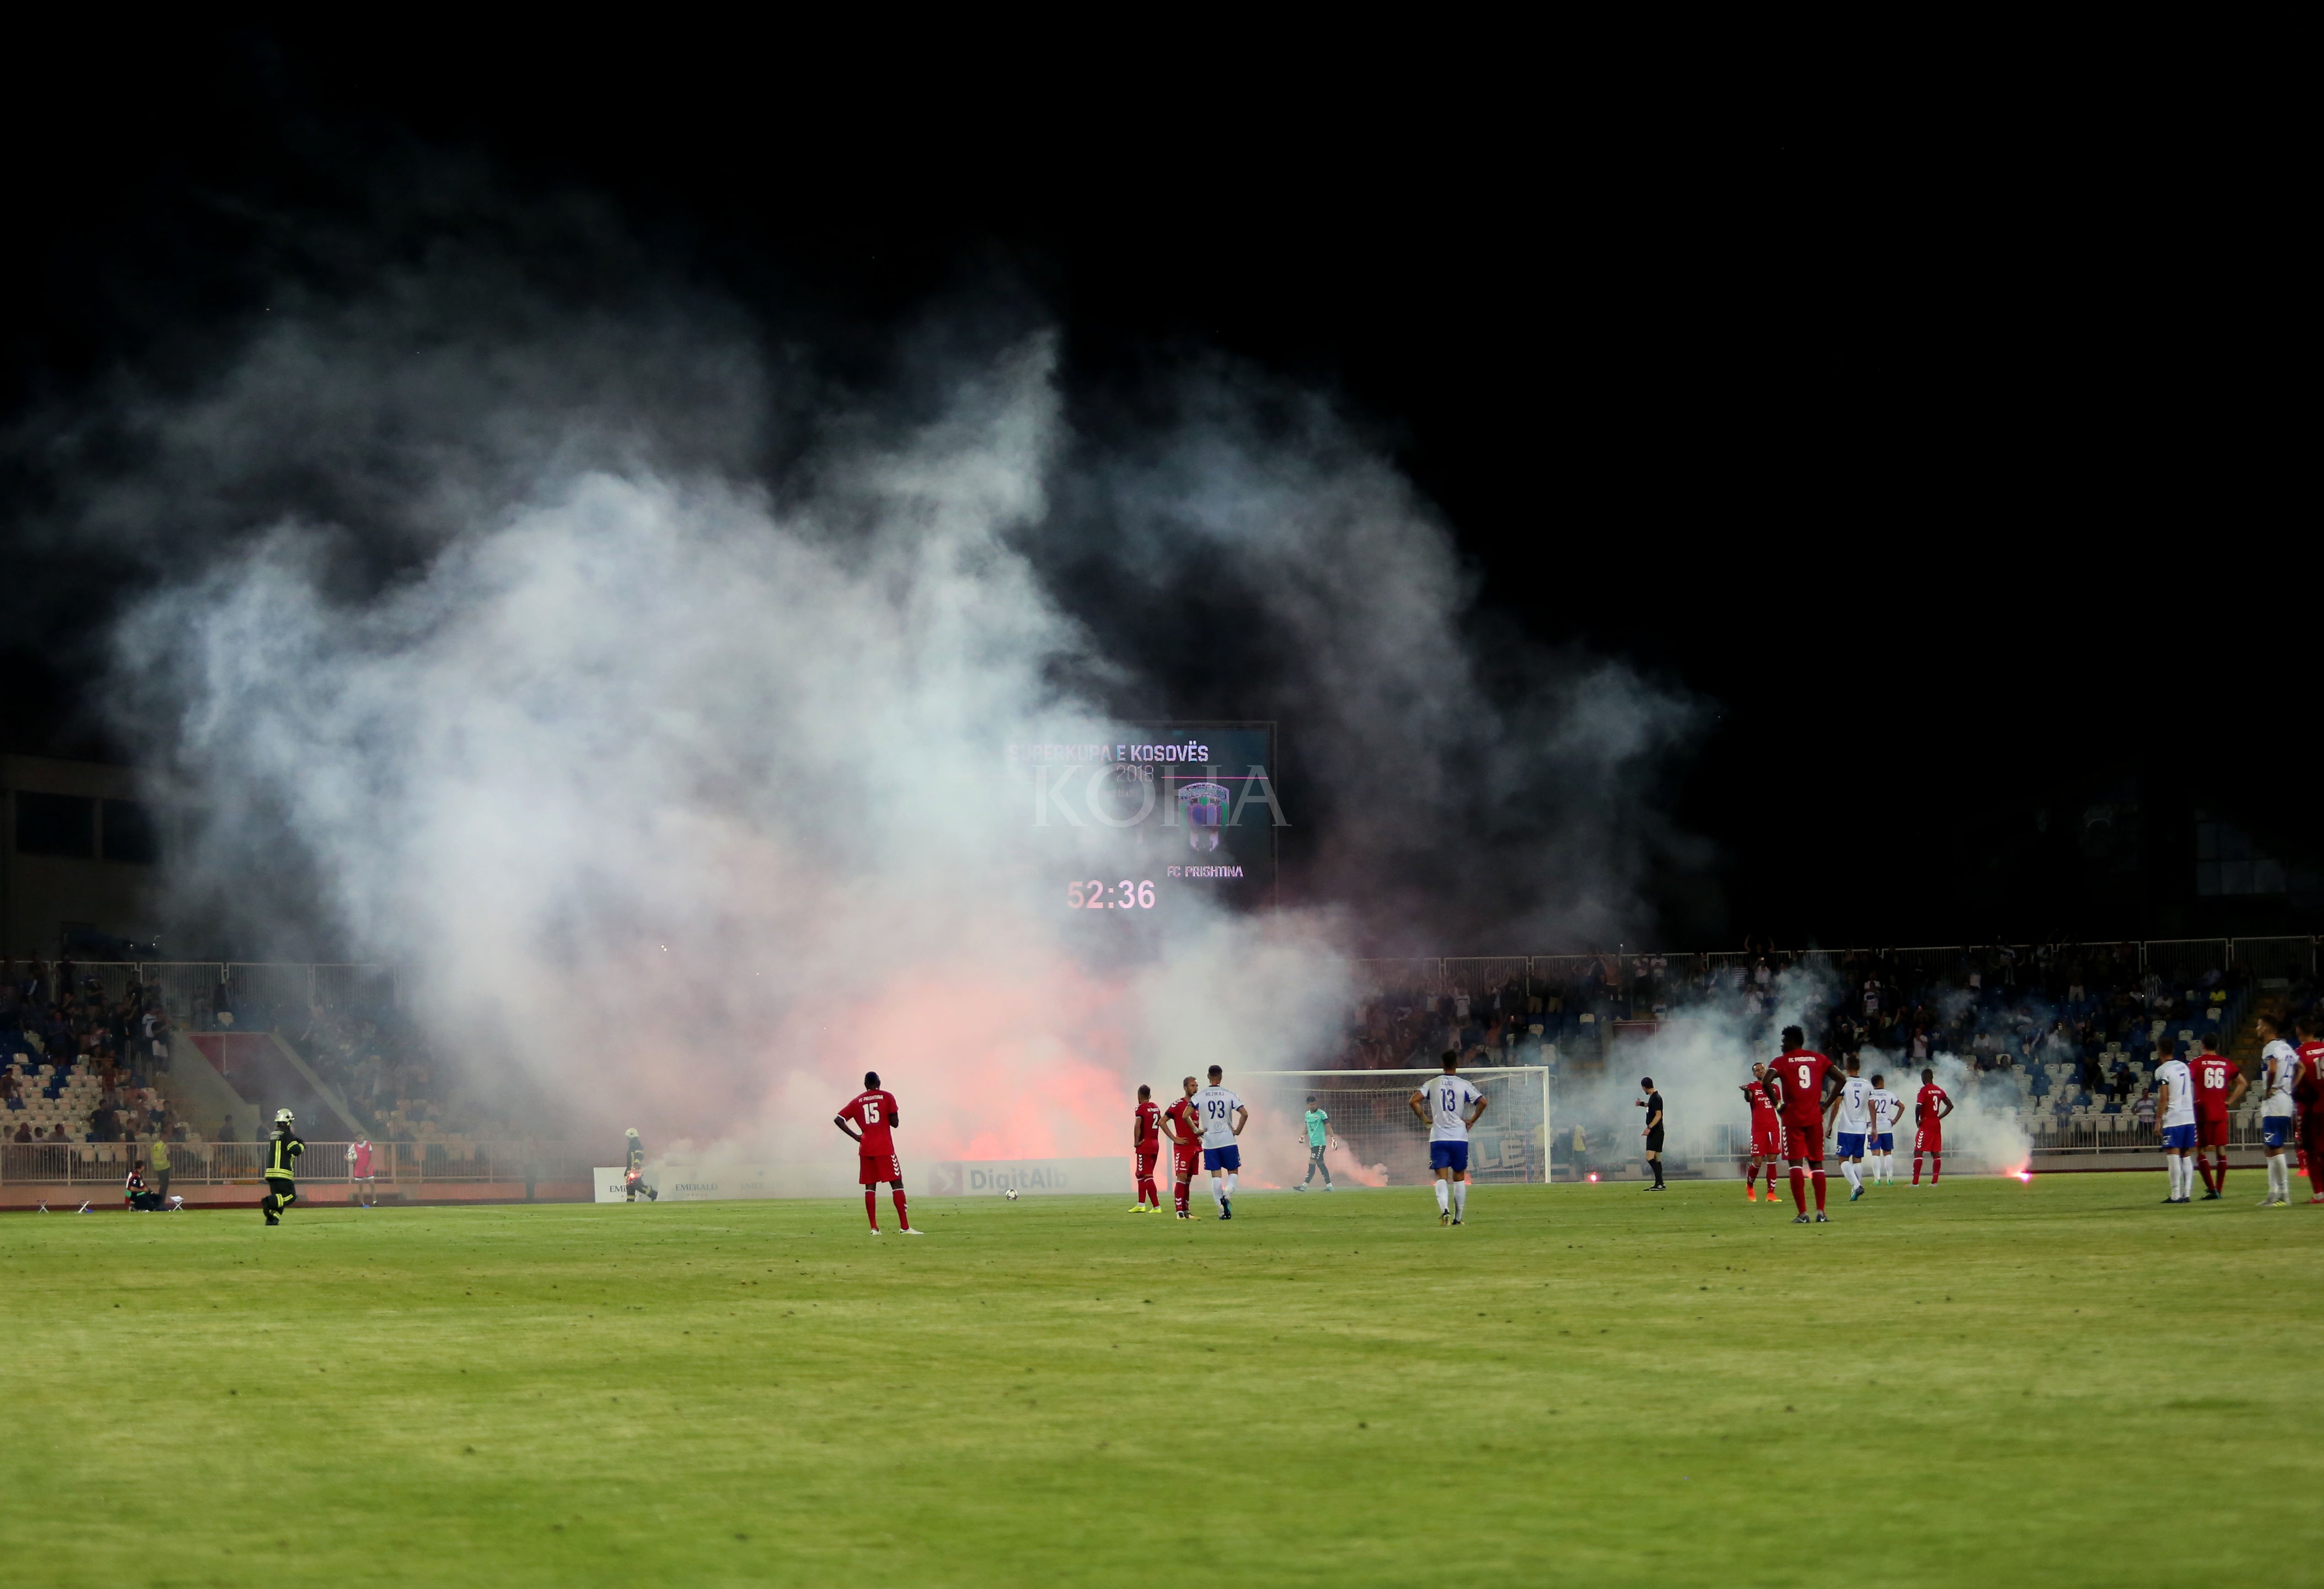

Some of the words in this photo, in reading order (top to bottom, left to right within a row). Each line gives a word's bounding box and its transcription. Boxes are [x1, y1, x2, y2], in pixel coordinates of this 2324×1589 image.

[1009, 744, 1112, 762] SUPERKUPA
[1117, 745, 1126, 761] E
[1131, 741, 1209, 762] KOSOVËS
[1116, 765, 1154, 782] 2018
[1167, 865, 1181, 877] FC
[1185, 865, 1243, 877] PRISHTINA
[1067, 880, 1156, 909] 52:36
[1799, 1065, 1810, 1088] 9
[2179, 1073, 2185, 1095] 7
[2204, 1067, 2225, 1089] 66
[1208, 1100, 1225, 1119] 93
[1441, 1089, 1456, 1111] 13
[1854, 1090, 1860, 1109] 5
[1874, 1099, 1886, 1113] 22
[1933, 1095, 1938, 1111] 3
[862, 1102, 880, 1124] 15
[1152, 1113, 1158, 1129] 2
[970, 1167, 1068, 1195] DigitAlb
